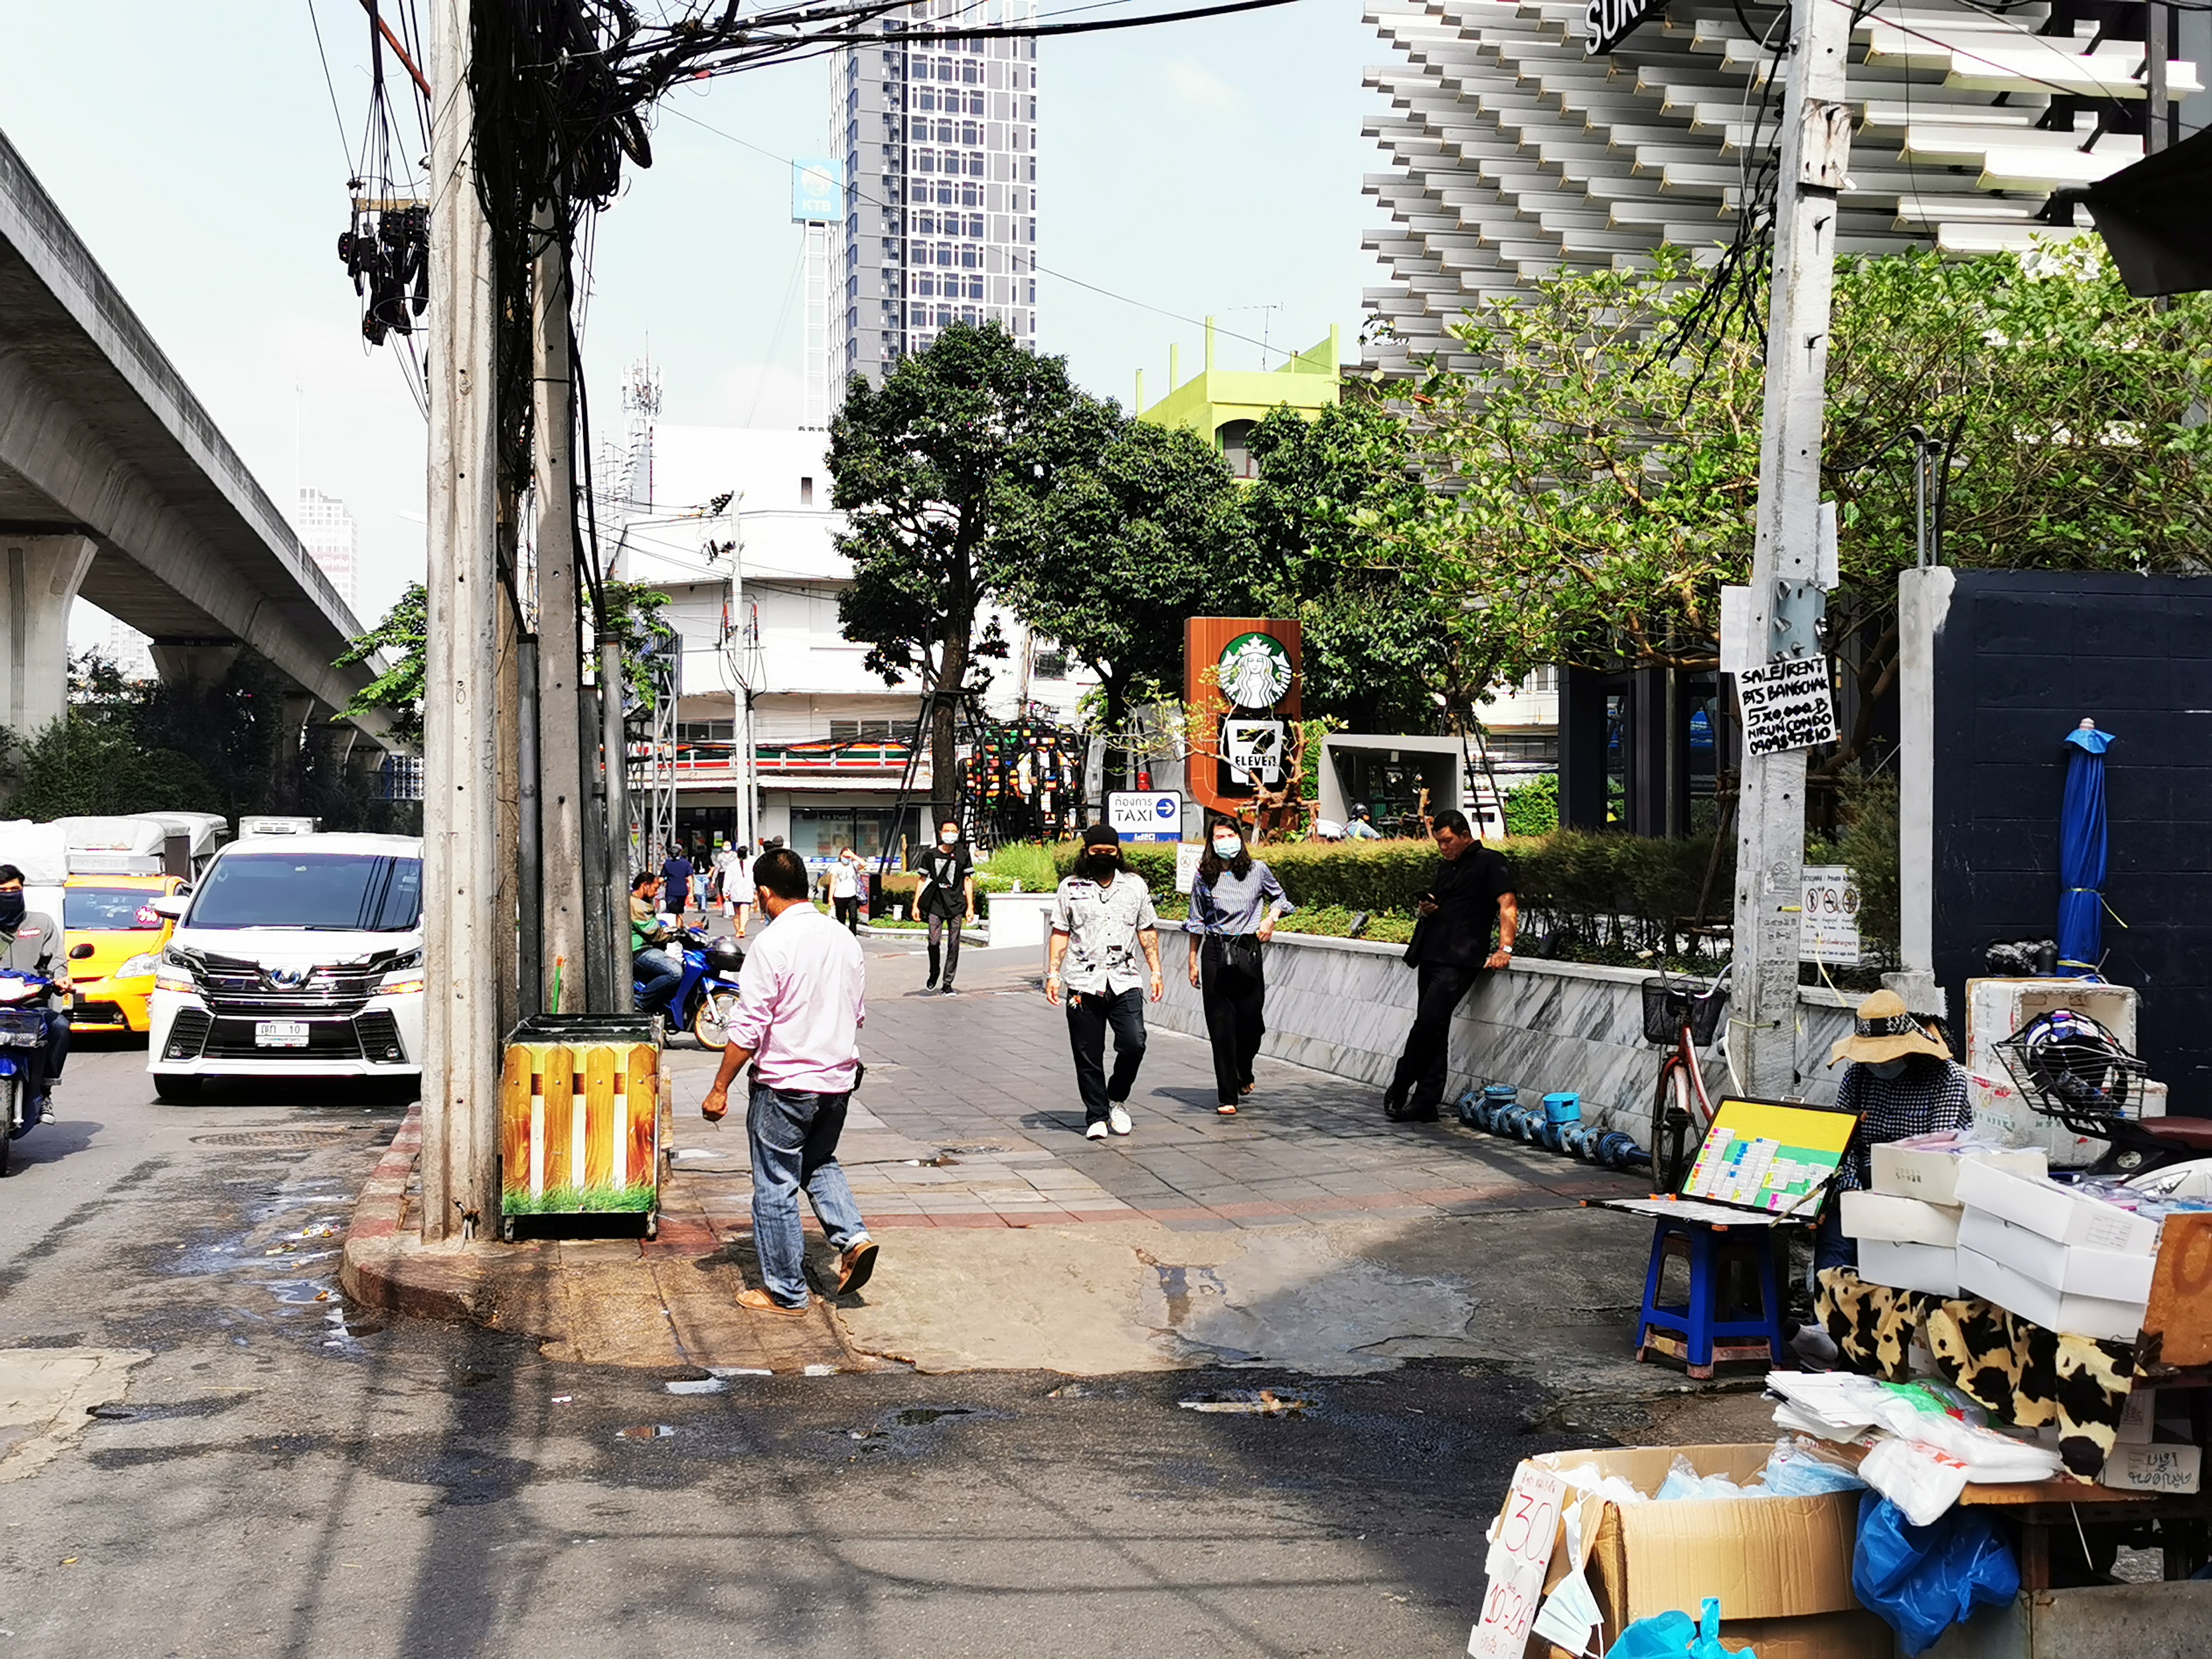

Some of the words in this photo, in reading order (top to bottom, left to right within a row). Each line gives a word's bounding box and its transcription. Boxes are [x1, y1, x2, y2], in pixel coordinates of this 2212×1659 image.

[802, 198, 831, 212] KTB
[1742, 687, 1765, 706] BTS
[1785, 712, 1832, 732] CONDO
[1115, 795, 1153, 806] ต้องการ
[1114, 809, 1152, 822] TAXI
[289, 1025, 301, 1034] 10
